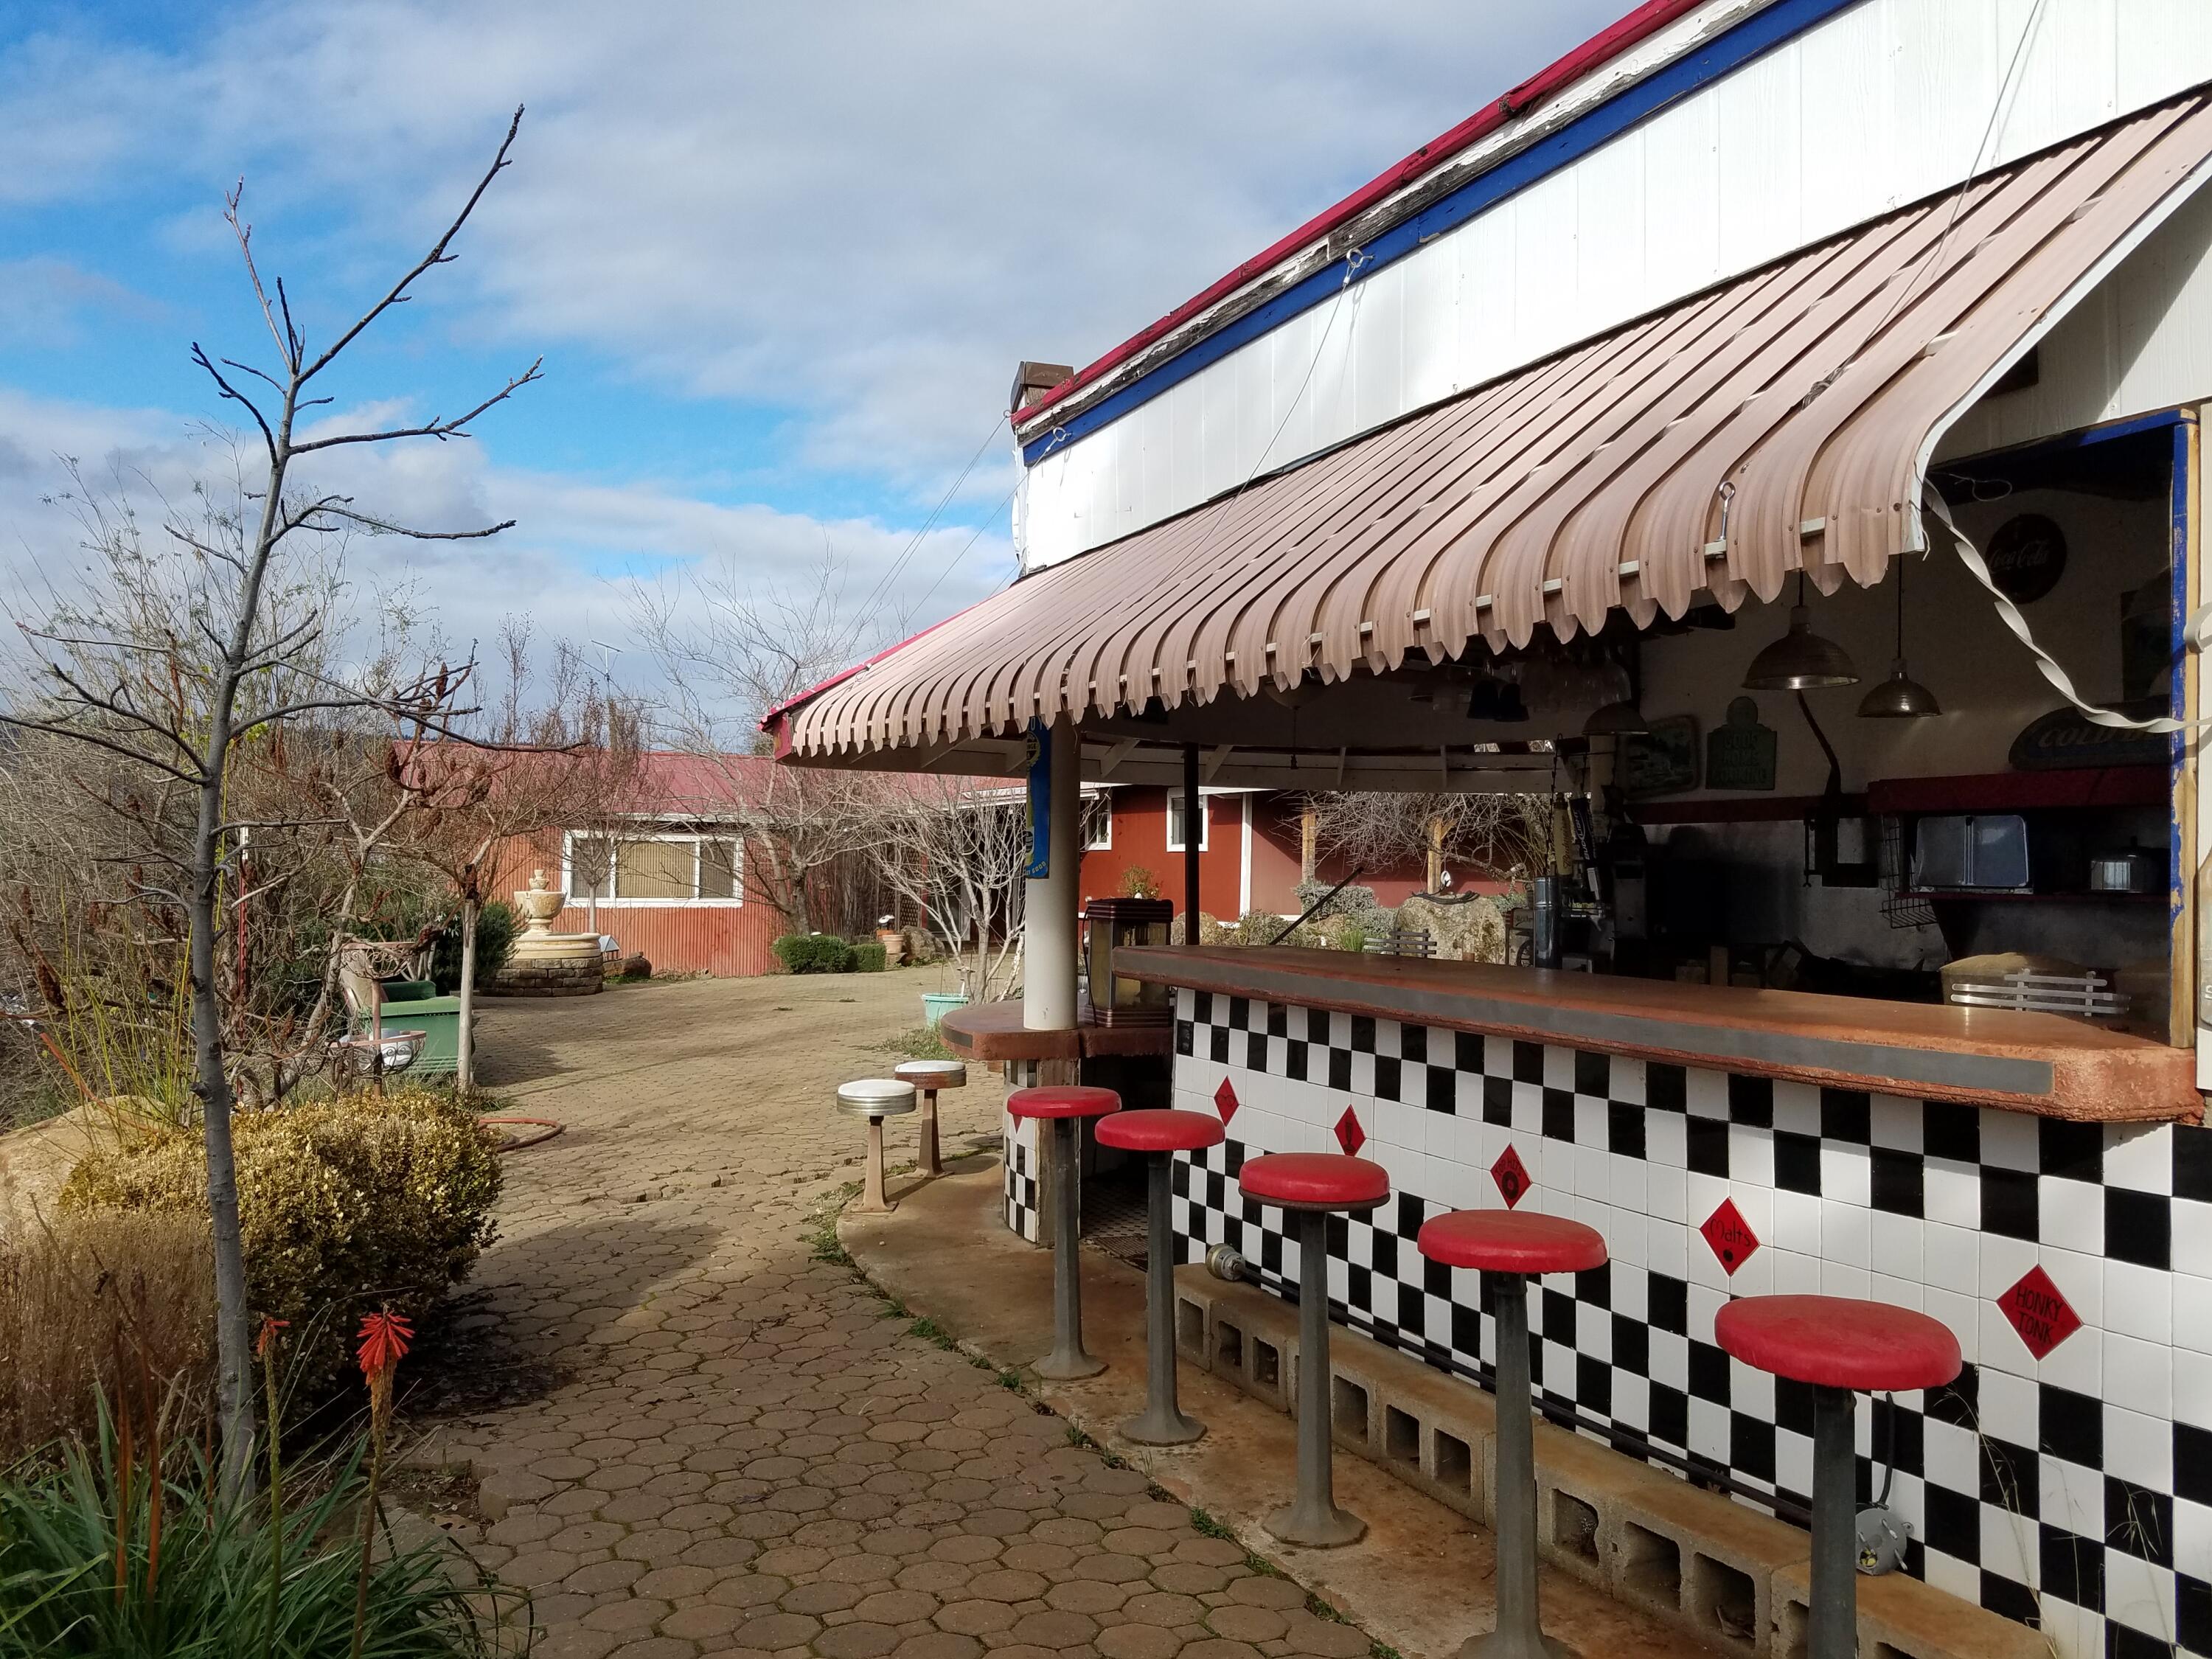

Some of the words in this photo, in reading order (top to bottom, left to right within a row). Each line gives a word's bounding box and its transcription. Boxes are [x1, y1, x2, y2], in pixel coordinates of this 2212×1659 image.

[1573, 810, 1583, 838] LIGHT
[1580, 839, 1590, 860] BUD
[1710, 1218, 1750, 1247] Malts
[2014, 1284, 2064, 1322] HONKY
[2017, 1311, 2053, 1346] TONK
